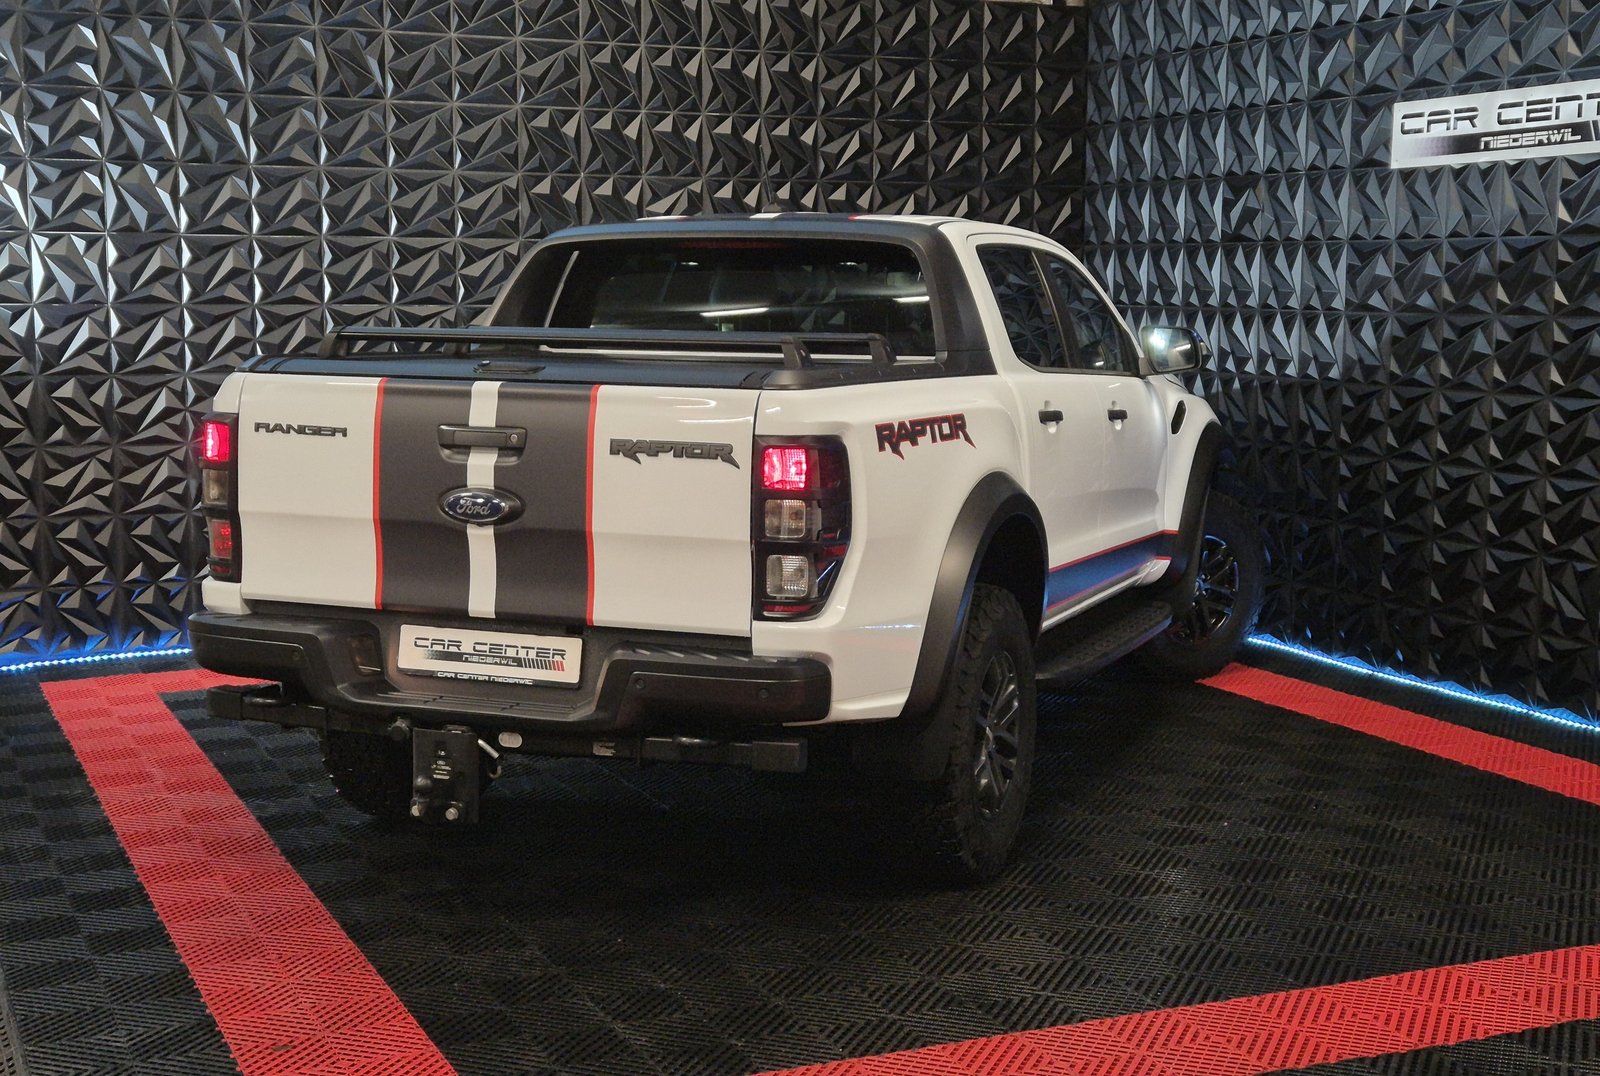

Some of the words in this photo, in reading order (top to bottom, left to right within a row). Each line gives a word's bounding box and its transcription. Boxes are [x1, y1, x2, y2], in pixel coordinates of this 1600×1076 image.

[1400, 106, 1480, 136] CAR
[1479, 128, 1582, 150] NIEDERWIL
[254, 422, 348, 438] RANGER
[874, 412, 977, 461] RAPTOR
[609, 438, 741, 470] RAPTOR
[456, 497, 492, 515] Ford
[413, 637, 463, 651] CAR
[472, 641, 567, 660] CENTER
[462, 654, 518, 666] NIEDERWIL
[457, 673, 489, 681] CENTER
[490, 676, 533, 685] NIEDERWIL
